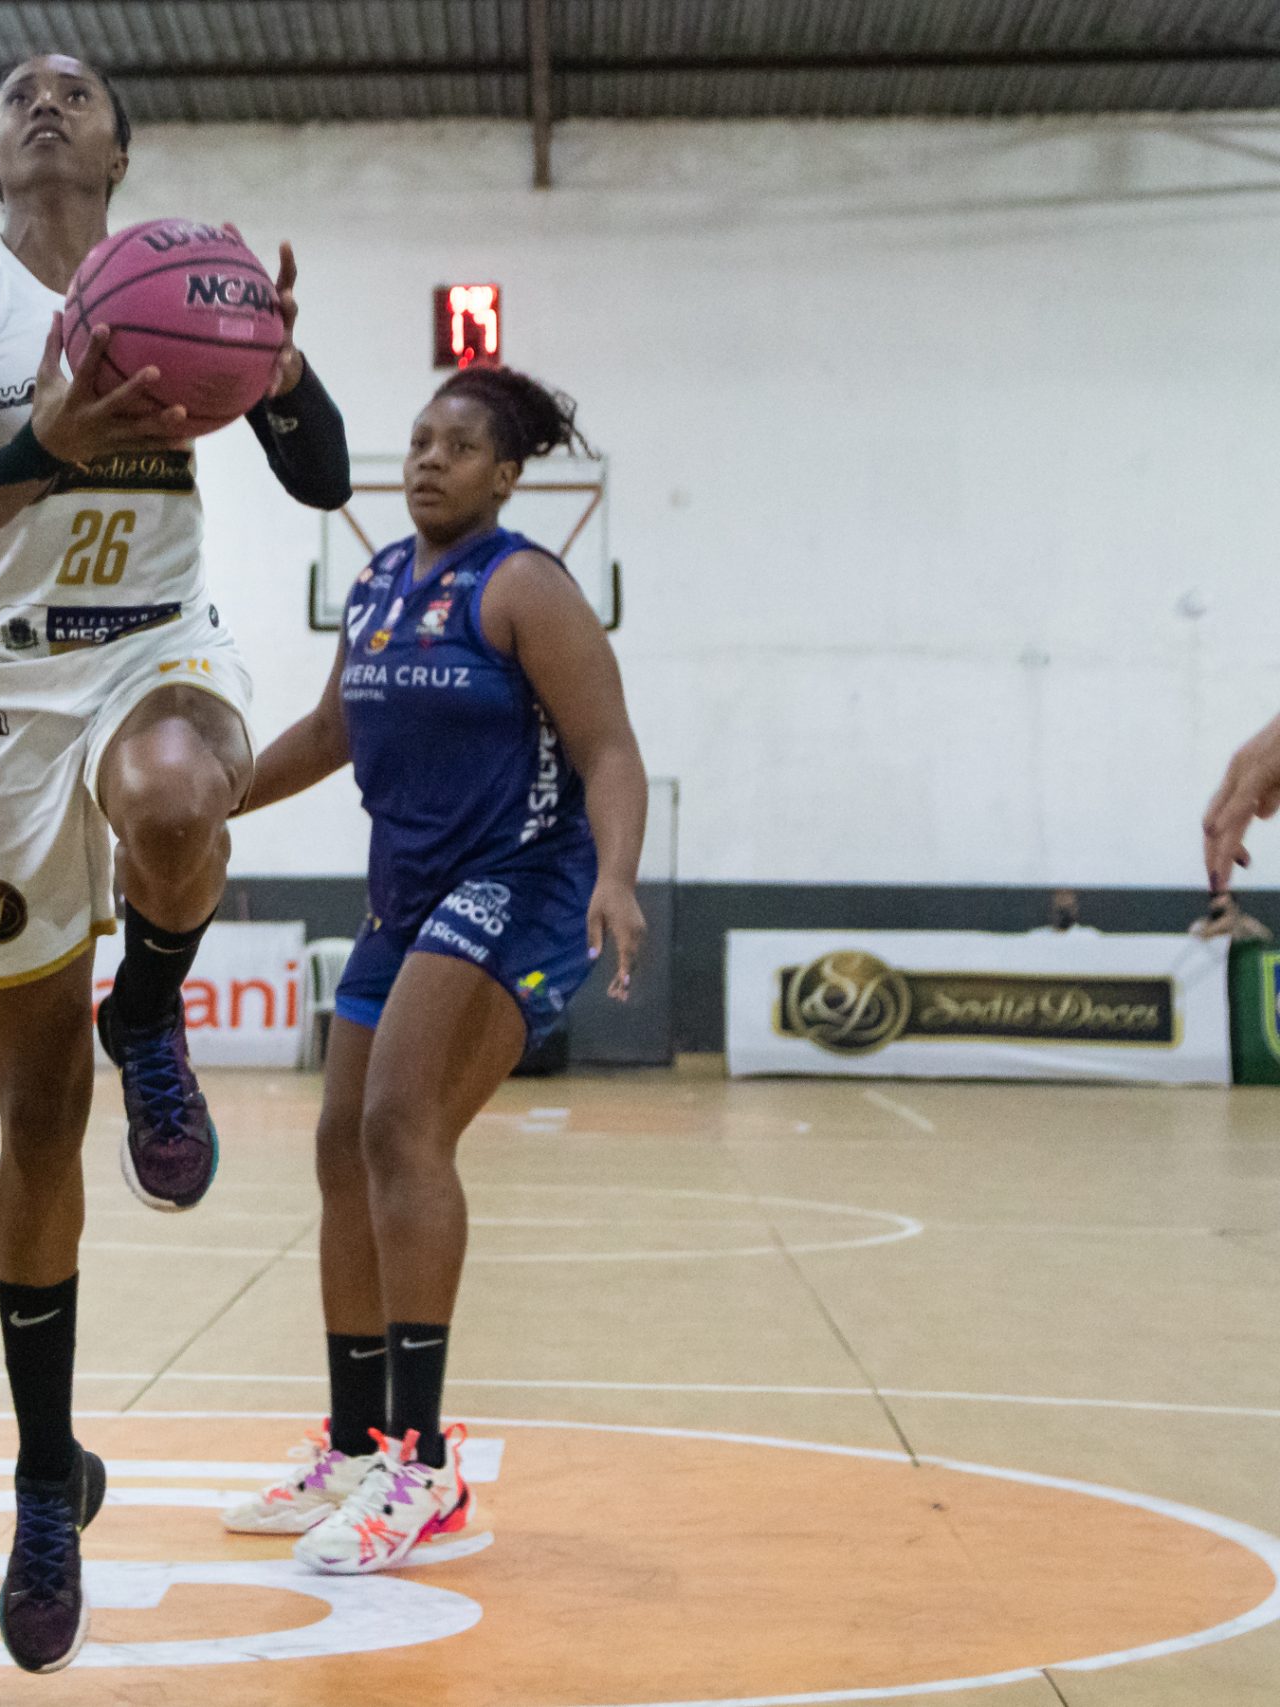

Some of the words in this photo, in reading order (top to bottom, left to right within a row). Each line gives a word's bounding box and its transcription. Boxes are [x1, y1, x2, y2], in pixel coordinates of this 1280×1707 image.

[55, 509, 137, 586] 26
[395, 665, 472, 688] CRUZ
[441, 892, 504, 936] MOOD
[430, 921, 489, 963] Sicredi
